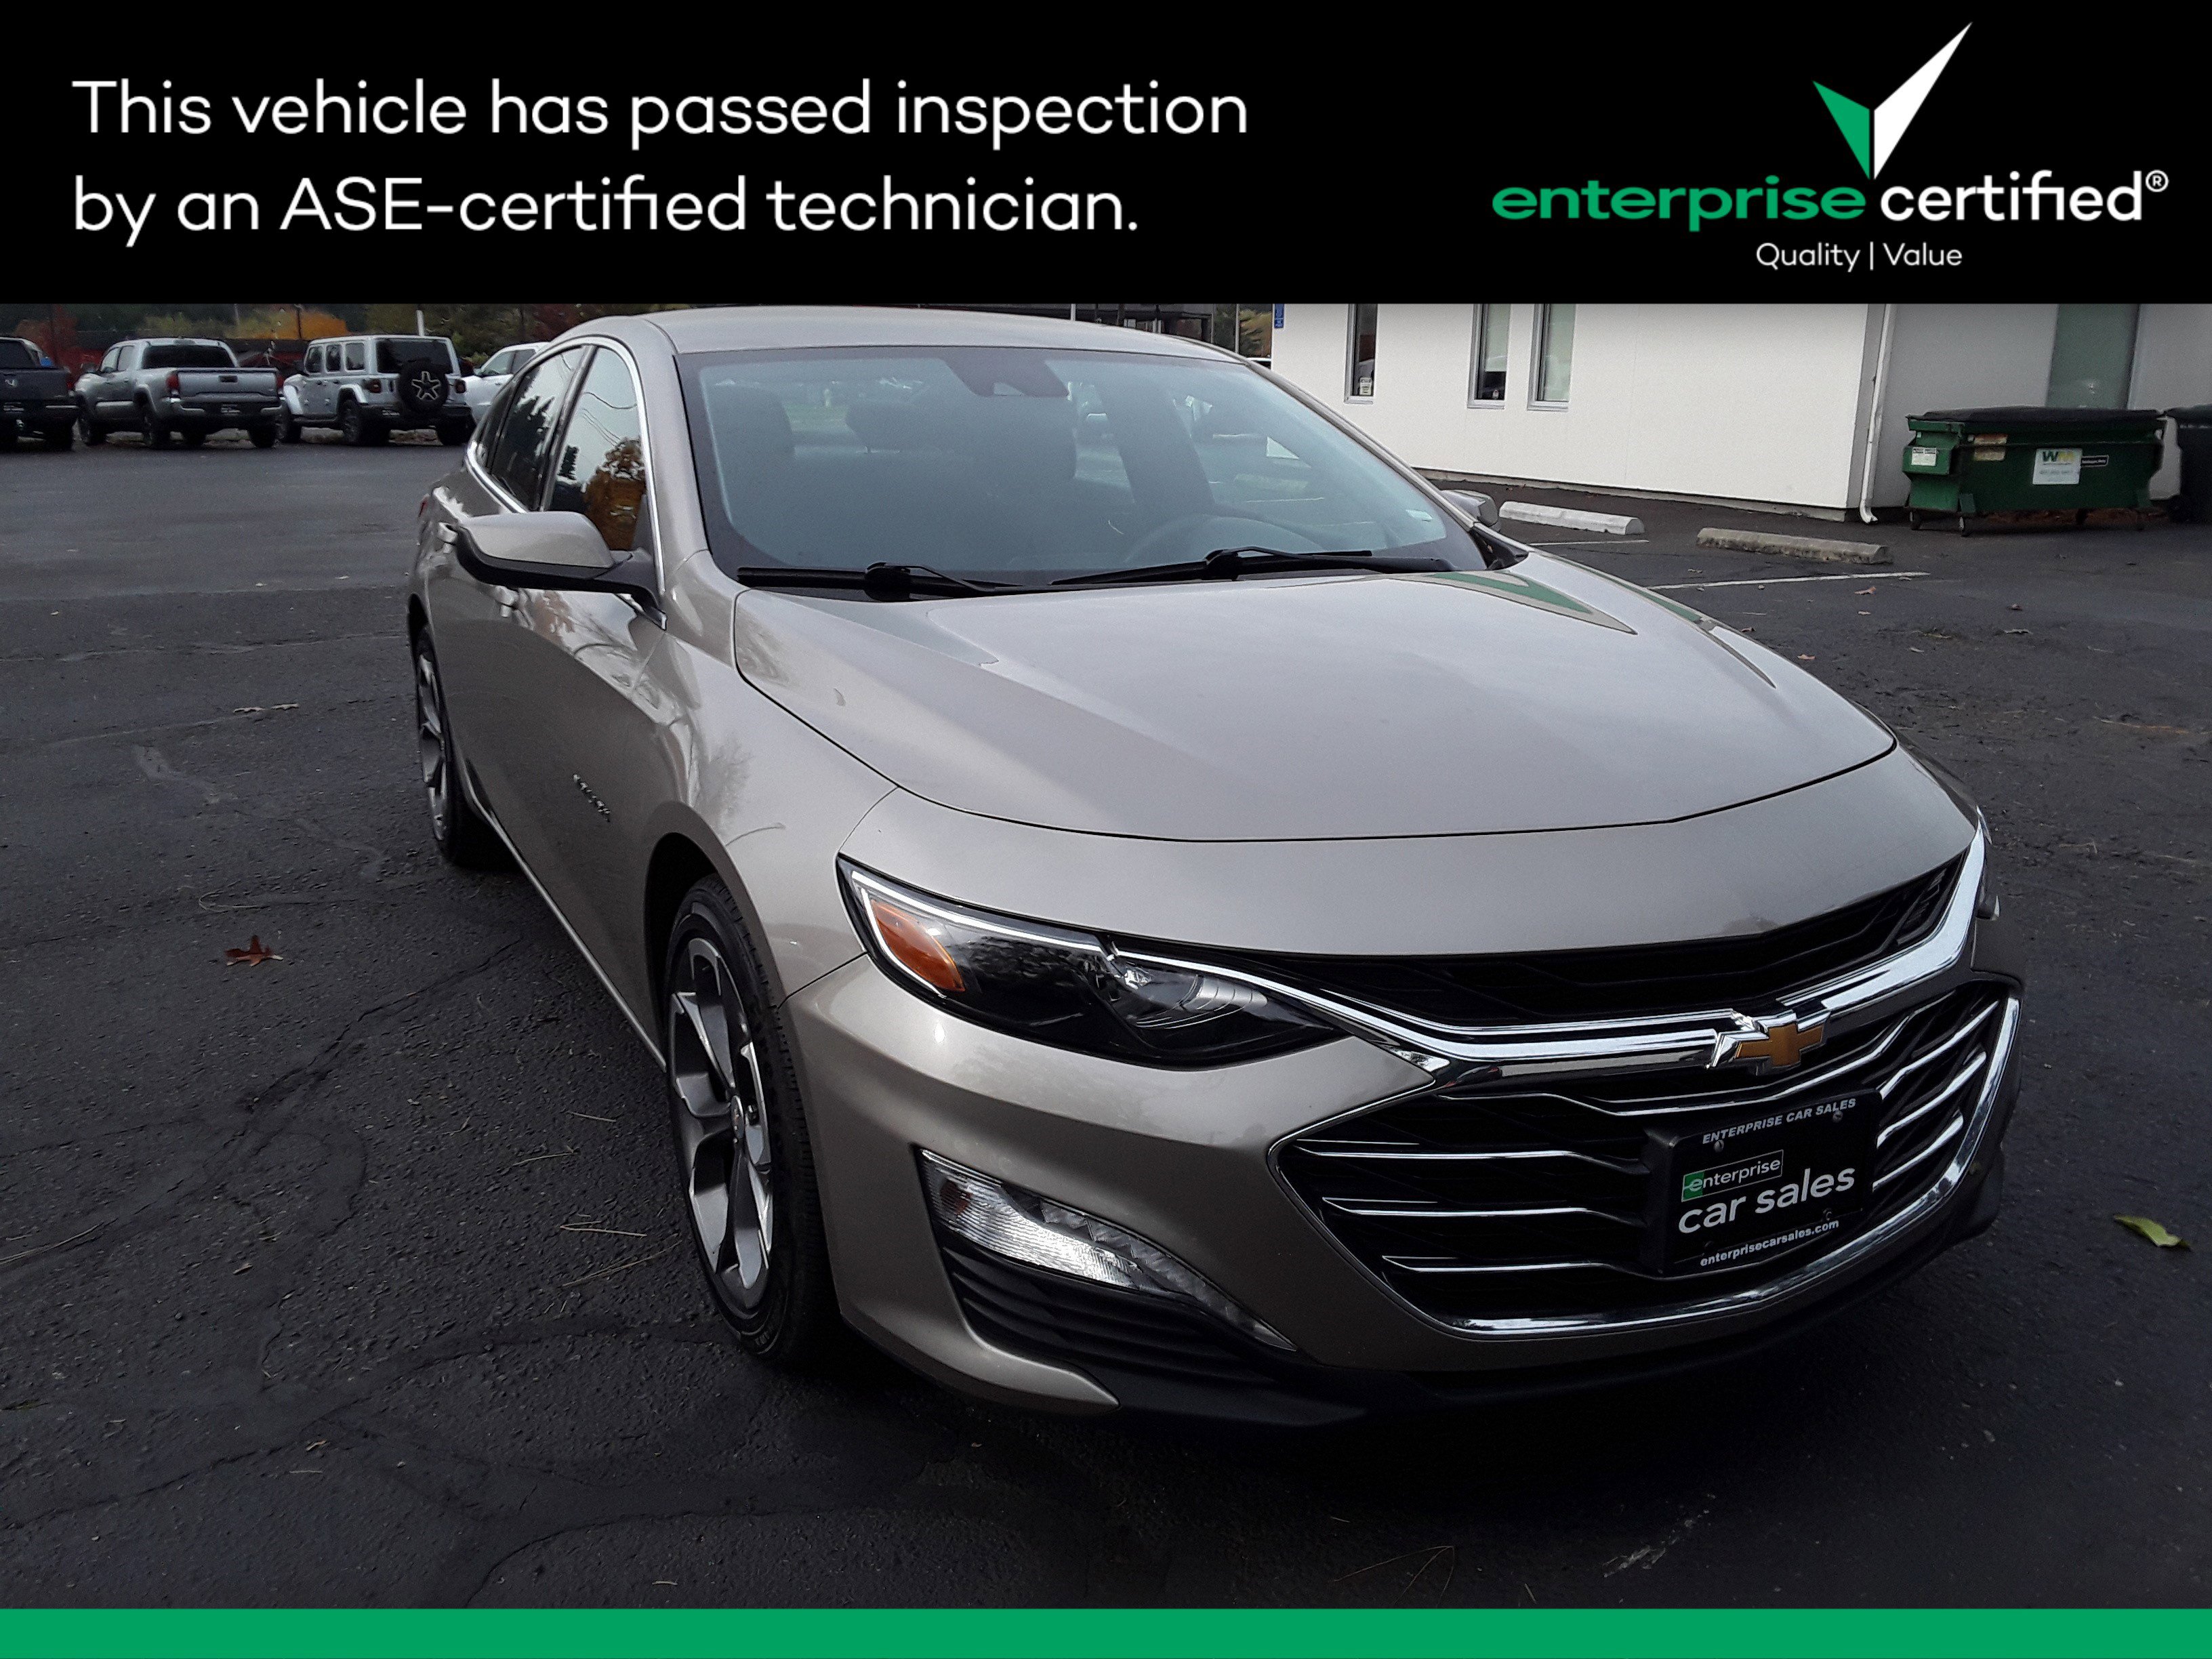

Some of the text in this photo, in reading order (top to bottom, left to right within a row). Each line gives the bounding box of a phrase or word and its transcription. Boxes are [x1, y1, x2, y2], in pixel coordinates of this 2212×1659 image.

[1702, 1099, 1856, 1144] ENTERPRISE CAR SALES
[1687, 1159, 1781, 1191] enterprise
[1679, 1168, 1856, 1233] car sales
[1700, 1220, 1839, 1267] enterprisecarsales.com
